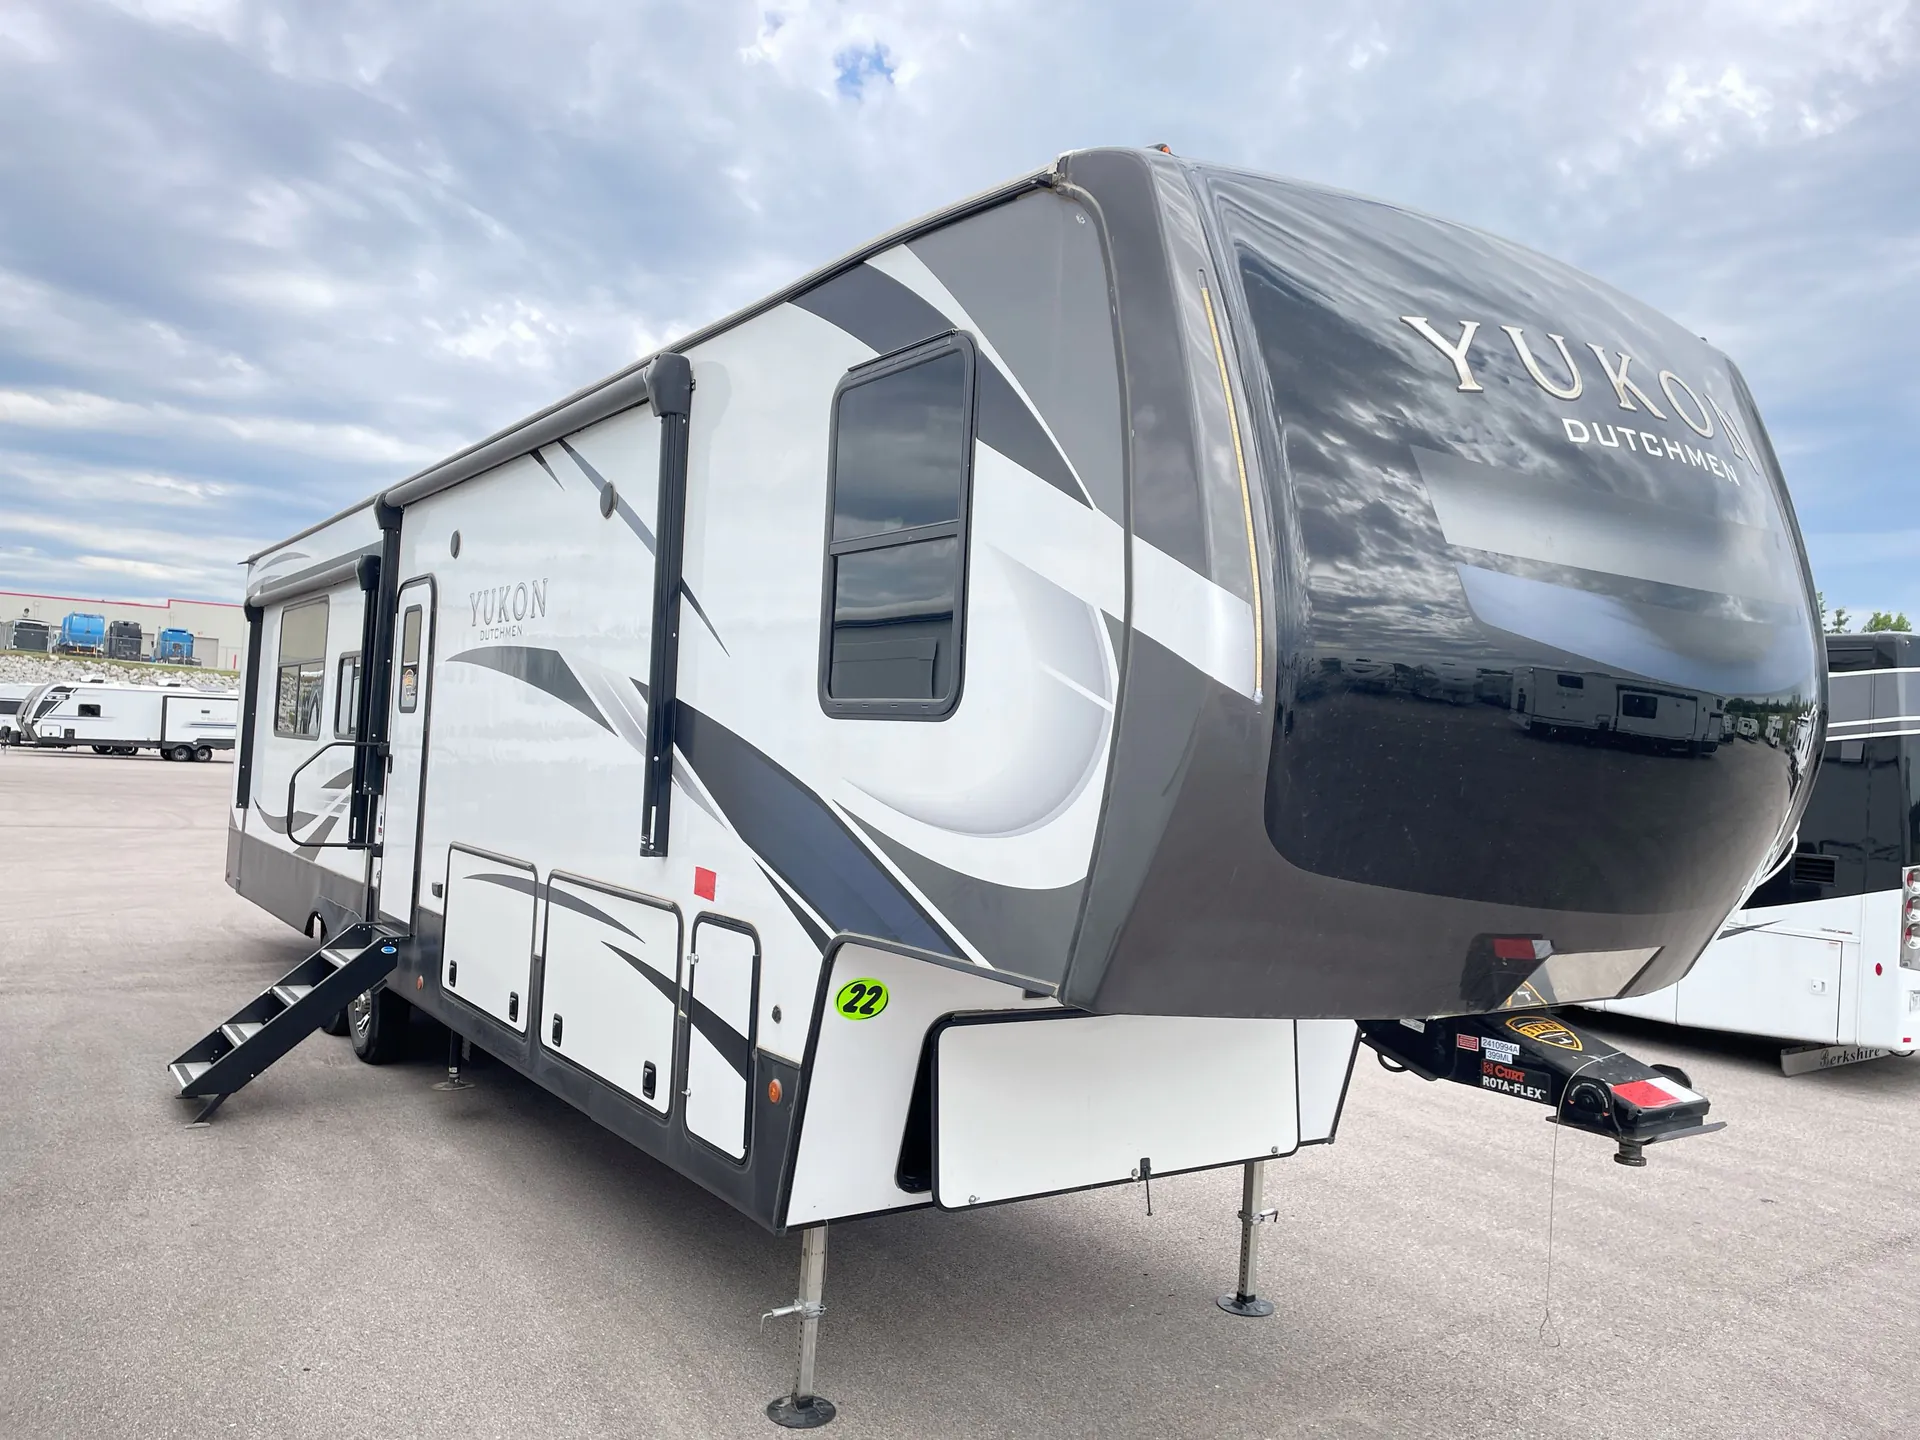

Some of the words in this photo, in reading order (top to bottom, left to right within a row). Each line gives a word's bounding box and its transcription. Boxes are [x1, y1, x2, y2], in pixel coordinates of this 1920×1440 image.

[1400, 316, 1759, 476] YUKON
[1562, 418, 1740, 486] DUTCHMEN
[469, 577, 548, 627] YUKON
[479, 624, 523, 641] DUTCHMEN
[842, 983, 883, 1015] 22
[1482, 1038, 1519, 1053] 2410994A
[1487, 1050, 1512, 1063] 399ML
[1819, 1047, 1880, 1068] Berkshire
[1482, 1075, 1542, 1100] ROTA-FLEX
